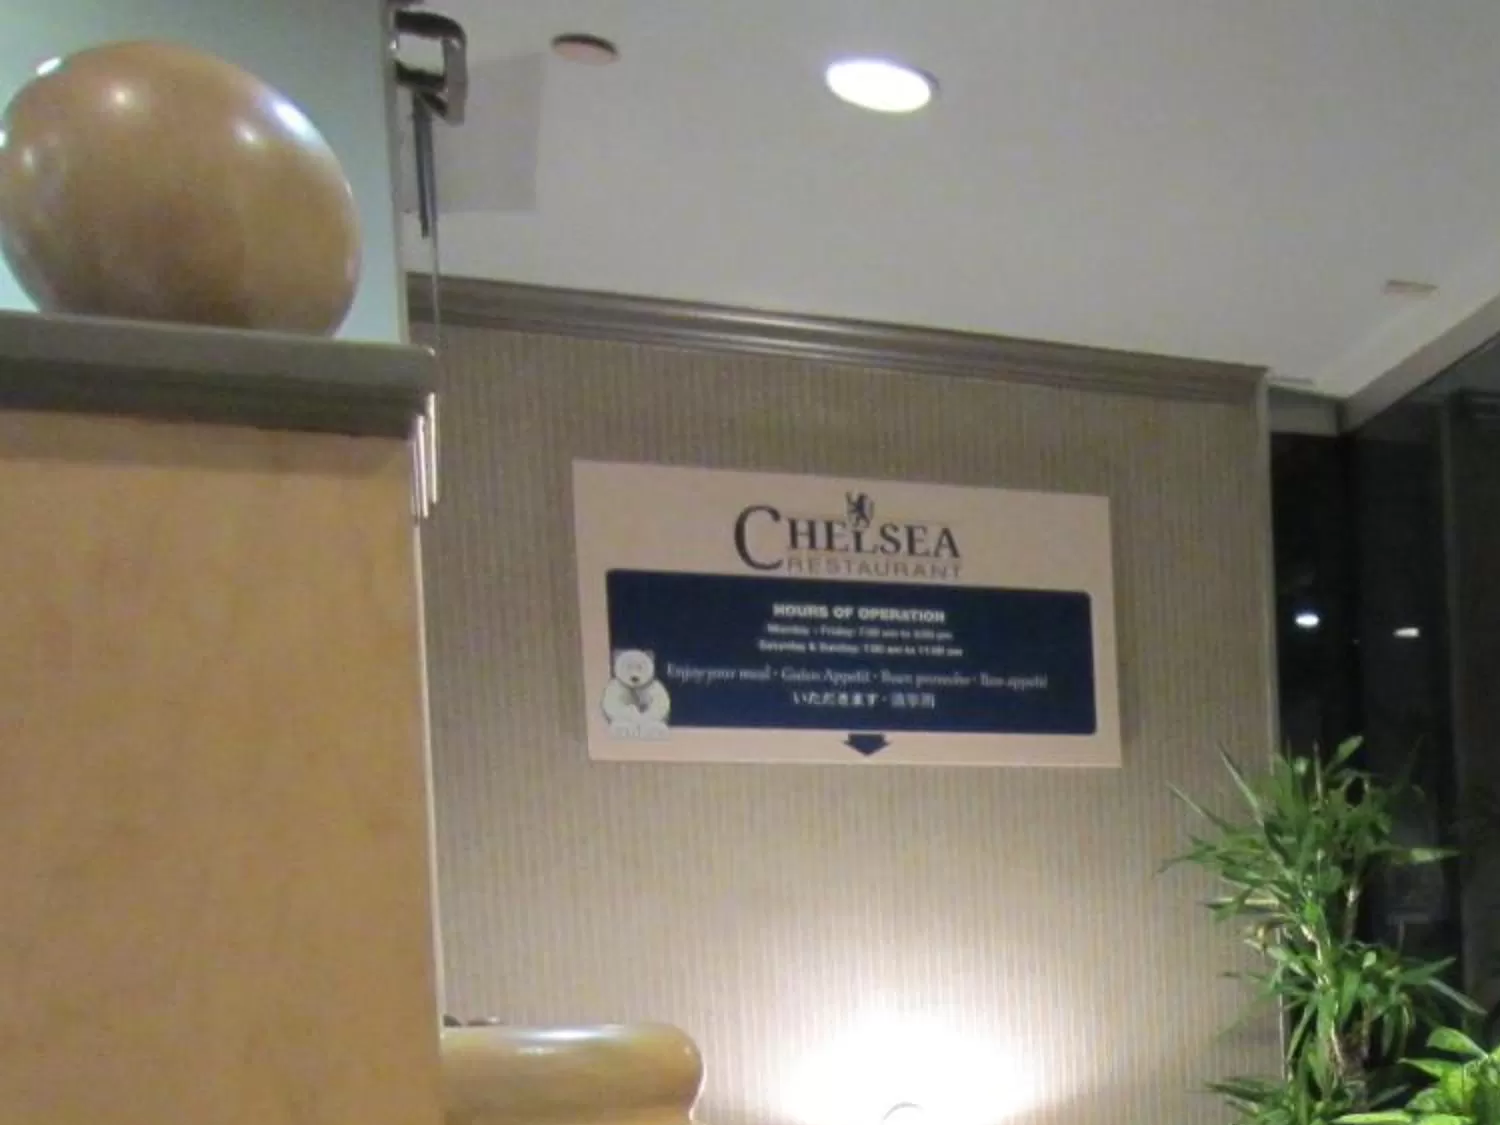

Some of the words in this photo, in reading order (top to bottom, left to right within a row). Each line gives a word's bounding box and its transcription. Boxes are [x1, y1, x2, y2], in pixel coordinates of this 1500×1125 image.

[733, 504, 961, 571] CHELSEA
[785, 555, 963, 579] RESTAURANT
[772, 603, 829, 619] HOURS
[832, 605, 854, 619] OF
[857, 607, 946, 623] OPERATION
[666, 662, 704, 686] Enjoy
[705, 668, 736, 687] your
[738, 664, 771, 681] meal
